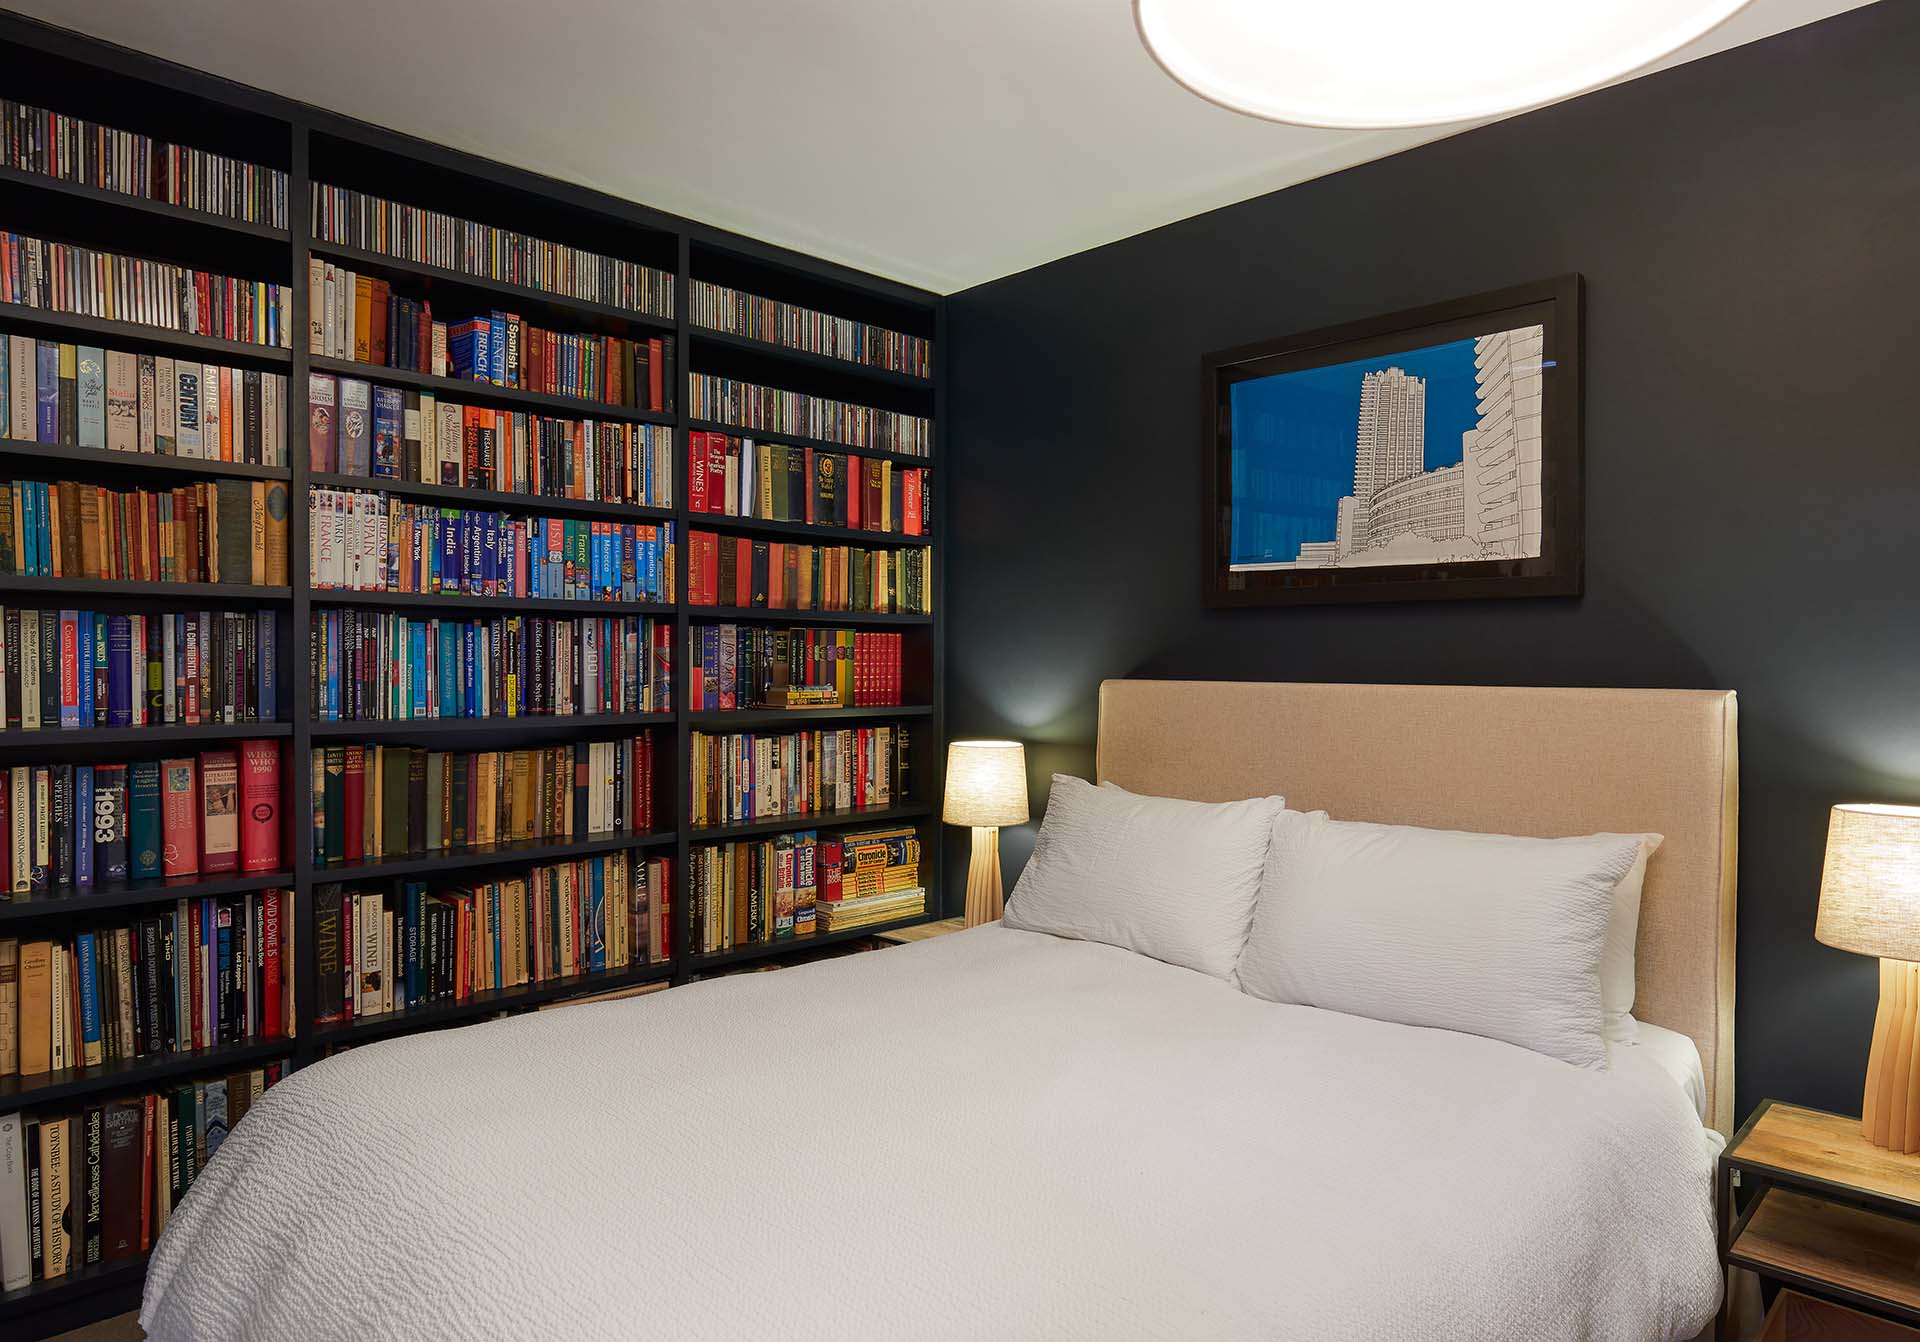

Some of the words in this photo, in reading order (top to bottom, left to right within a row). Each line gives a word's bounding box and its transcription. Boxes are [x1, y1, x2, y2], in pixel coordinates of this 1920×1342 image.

[478, 332, 488, 372] FRENCH
[493, 326, 503, 372] FRENCH
[507, 324, 518, 369] Spanish
[179, 374, 198, 431] CENTURY
[206, 368, 217, 410] EMPIRE
[443, 414, 453, 459] Shakespeare
[321, 514, 331, 564] FRANCE
[334, 516, 343, 544] PARIS
[364, 518, 375, 556] SPAIN
[446, 527, 455, 555] India
[472, 526, 481, 566] Argentina
[485, 529, 495, 550] Italy
[551, 523, 560, 547] USA
[624, 537, 632, 559] India
[578, 534, 587, 563] France
[187, 622, 196, 632] FA
[311, 632, 316, 640] Mr
[187, 632, 196, 679] CONFIDENTIAL
[534, 683, 542, 702] Style
[17, 782, 25, 811] ENGLISH
[17, 813, 25, 855] COMPANION
[95, 793, 115, 843] 1993
[857, 850, 886, 861] Chronicle
[636, 860, 646, 901] VOGUE
[267, 889, 278, 918] DAVID
[267, 919, 278, 949] BOWIE
[319, 914, 337, 976] WINE
[366, 932, 377, 968] WINE
[49, 1125, 60, 1168] TOYNBEE
[170, 1120, 178, 1156] TOULOUSE
[185, 1125, 193, 1146] PARIS
[186, 1149, 193, 1157] IN
[51, 1182, 60, 1211] STUDY
[86, 1165, 100, 1223] Merveilleuses
[51, 1213, 60, 1224] OF
[33, 1226, 41, 1259] ADVERTISING
[51, 1229, 61, 1265] HISTORY
